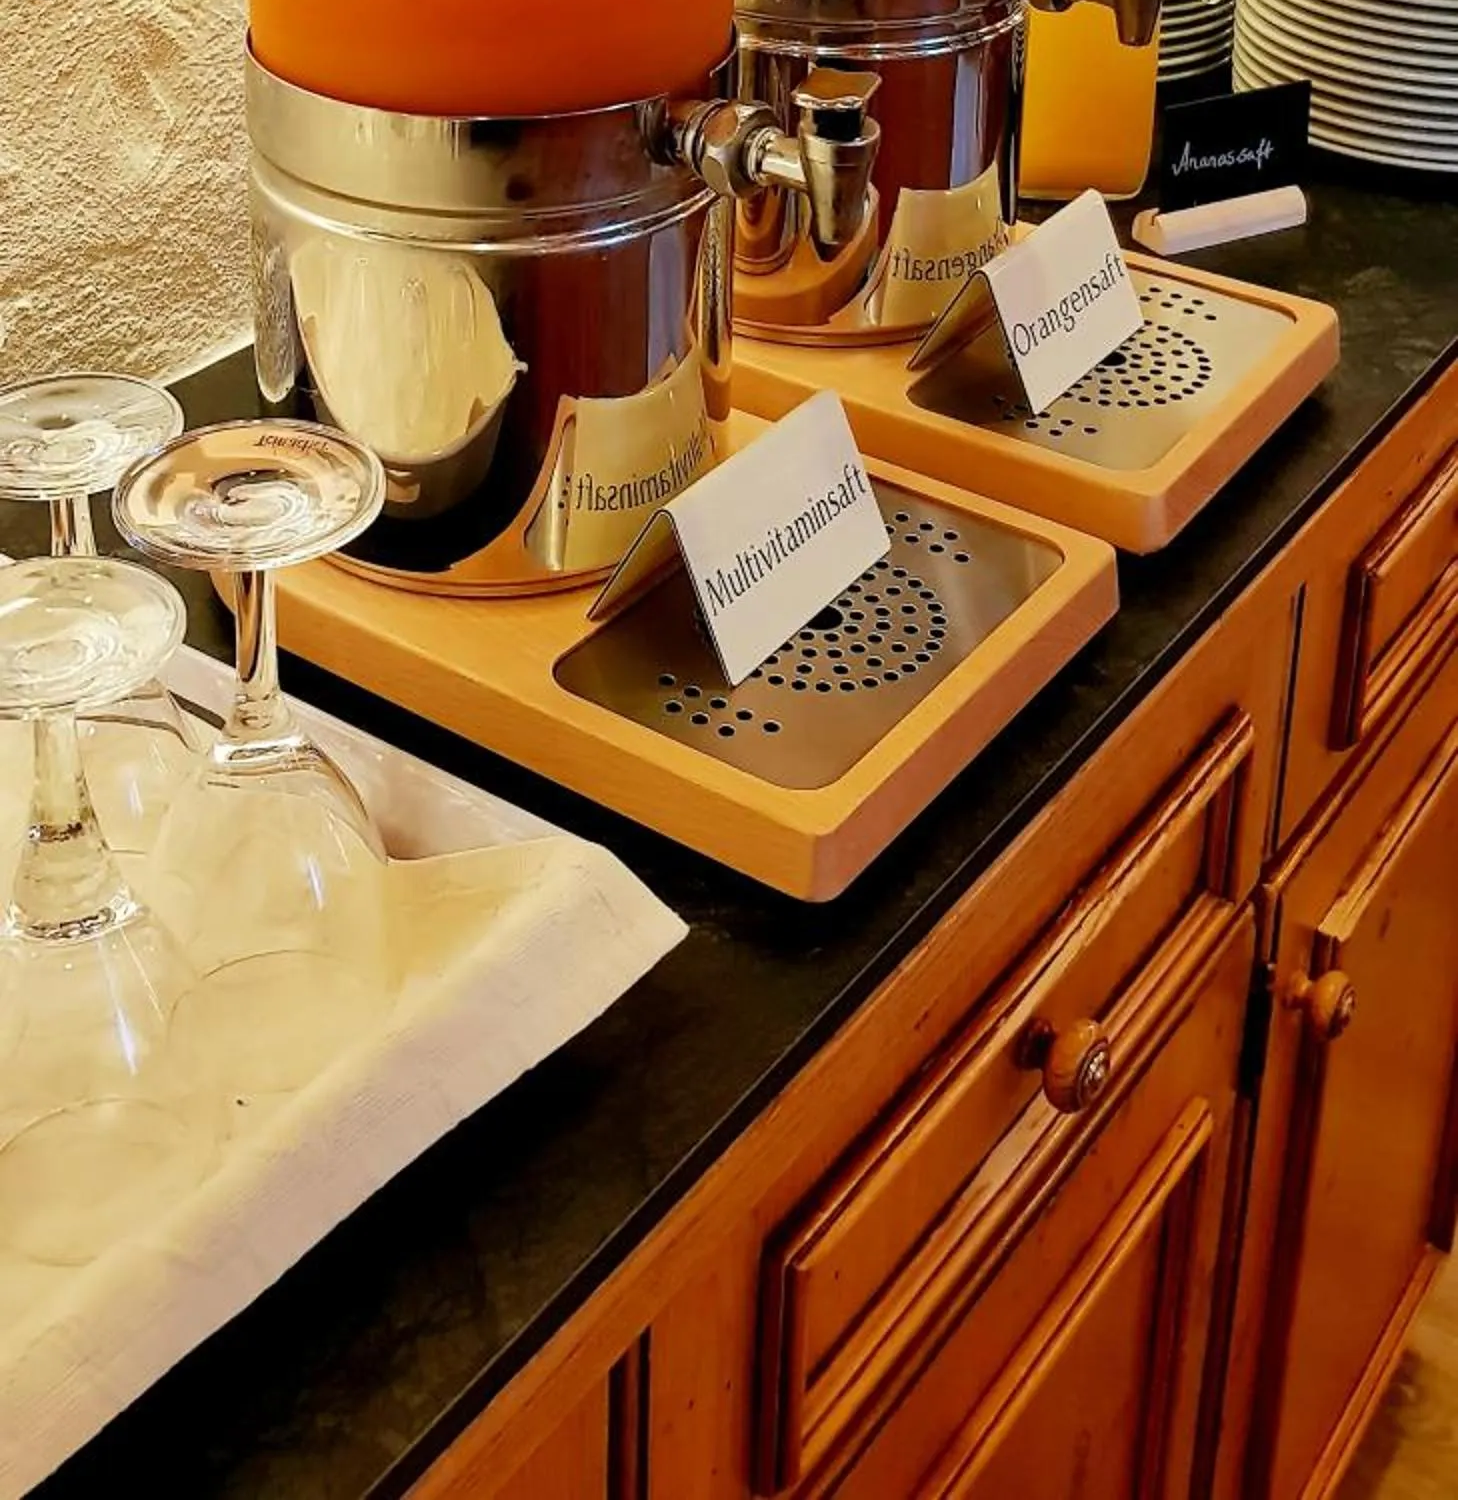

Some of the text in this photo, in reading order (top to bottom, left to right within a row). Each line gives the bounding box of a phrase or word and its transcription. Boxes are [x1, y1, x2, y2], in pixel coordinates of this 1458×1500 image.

[1171, 137, 1274, 177] Ananassaft
[1013, 253, 1126, 357] Orangensaft
[704, 463, 867, 616] Multivitaminsaft
